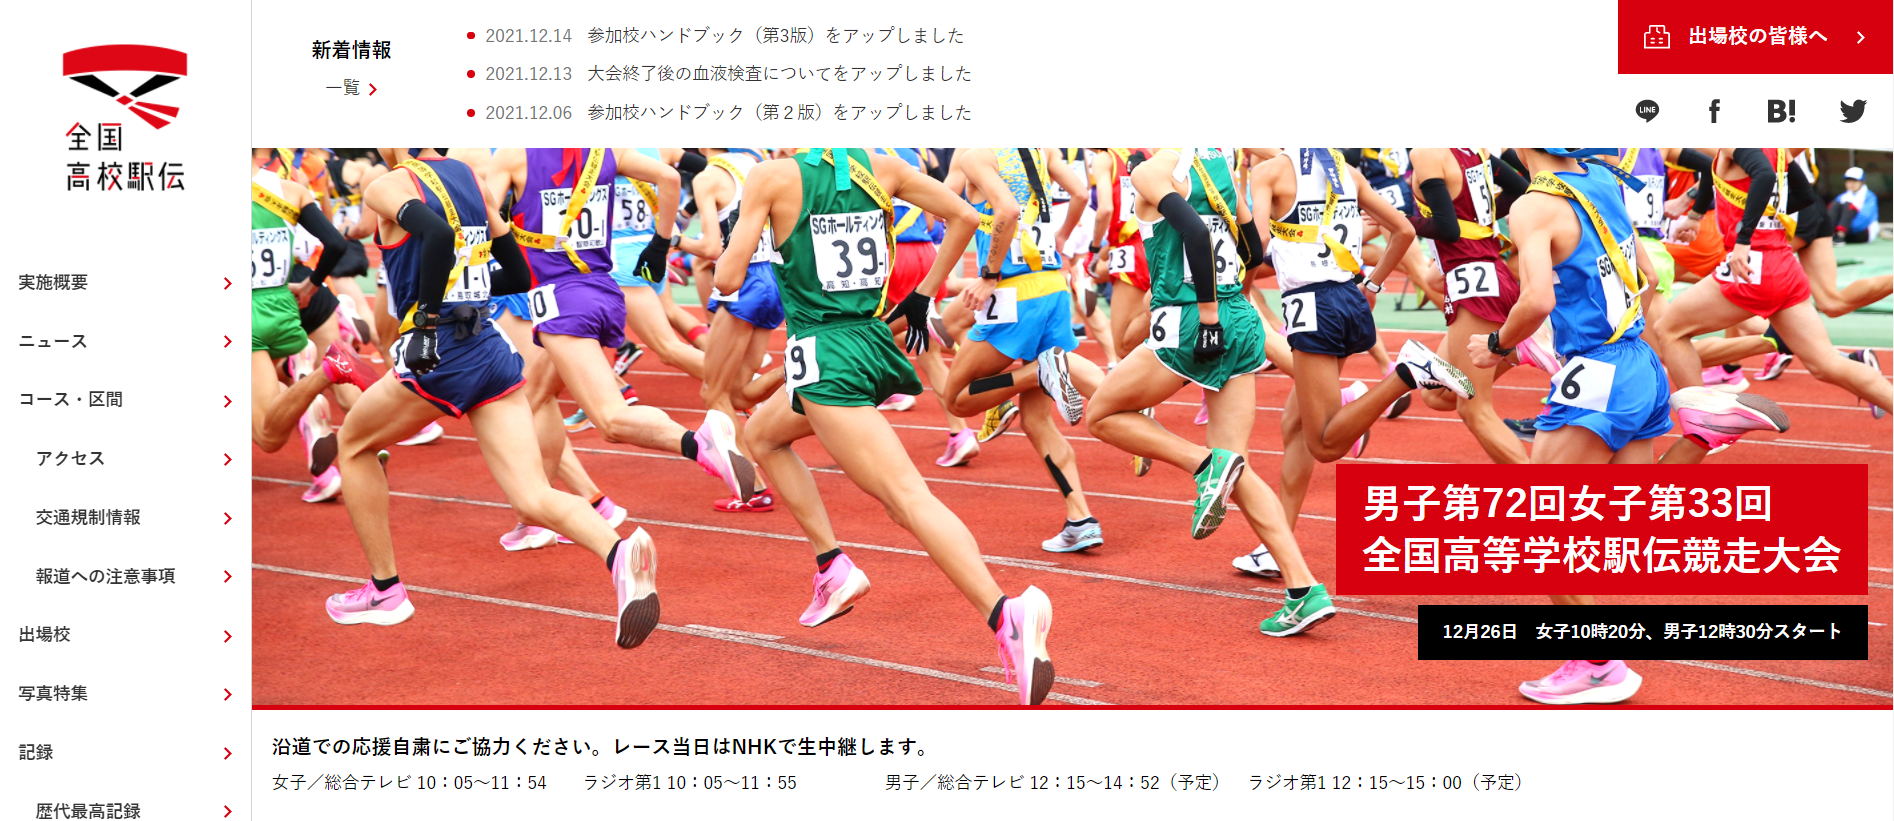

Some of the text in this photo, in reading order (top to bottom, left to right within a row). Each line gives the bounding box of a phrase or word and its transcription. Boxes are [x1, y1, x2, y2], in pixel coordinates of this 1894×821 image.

[486, 25, 964, 45] 2021.12.14 参加校ハンドブック（第3版）をアップしました
[1688, 25, 1828, 46] 出場校の皆様へ
[311, 39, 392, 60] 新着情報
[486, 63, 972, 82] 2021.12.13 大会終了後の血液検査についてをアップしました
[325, 78, 361, 96] 一覧
[486, 102, 972, 122] 2021.12.06 参加校ハンドブック（第２版）をアップしました
[1639, 106, 1656, 114] LINE
[66, 121, 122, 152] 全国
[66, 161, 185, 192] 高校駅伝
[18, 273, 89, 291] 実施概要
[1454, 265, 1490, 295] 52
[18, 334, 87, 349] ニュース
[1560, 363, 1586, 400] 6
[20, 390, 123, 408] コース・区間
[36, 450, 105, 467] アクセス
[35, 508, 141, 526] 交通規制情報
[35, 567, 176, 585] 報道への注意事項
[19, 625, 71, 643] 出場校
[18, 684, 88, 702] 写真特集
[18, 743, 54, 761] 記録
[271, 736, 925, 757] 沿道での応援自粛にご協力ください。レース当日はNHKで生中継します。
[271, 773, 412, 791] 女子／総合テレビ
[584, 773, 662, 791] ラジオ第1
[885, 773, 1025, 791] 男子／総合テレビ
[1249, 773, 1327, 791] ラジオ第1
[35, 802, 141, 820] 歴代最高記録
